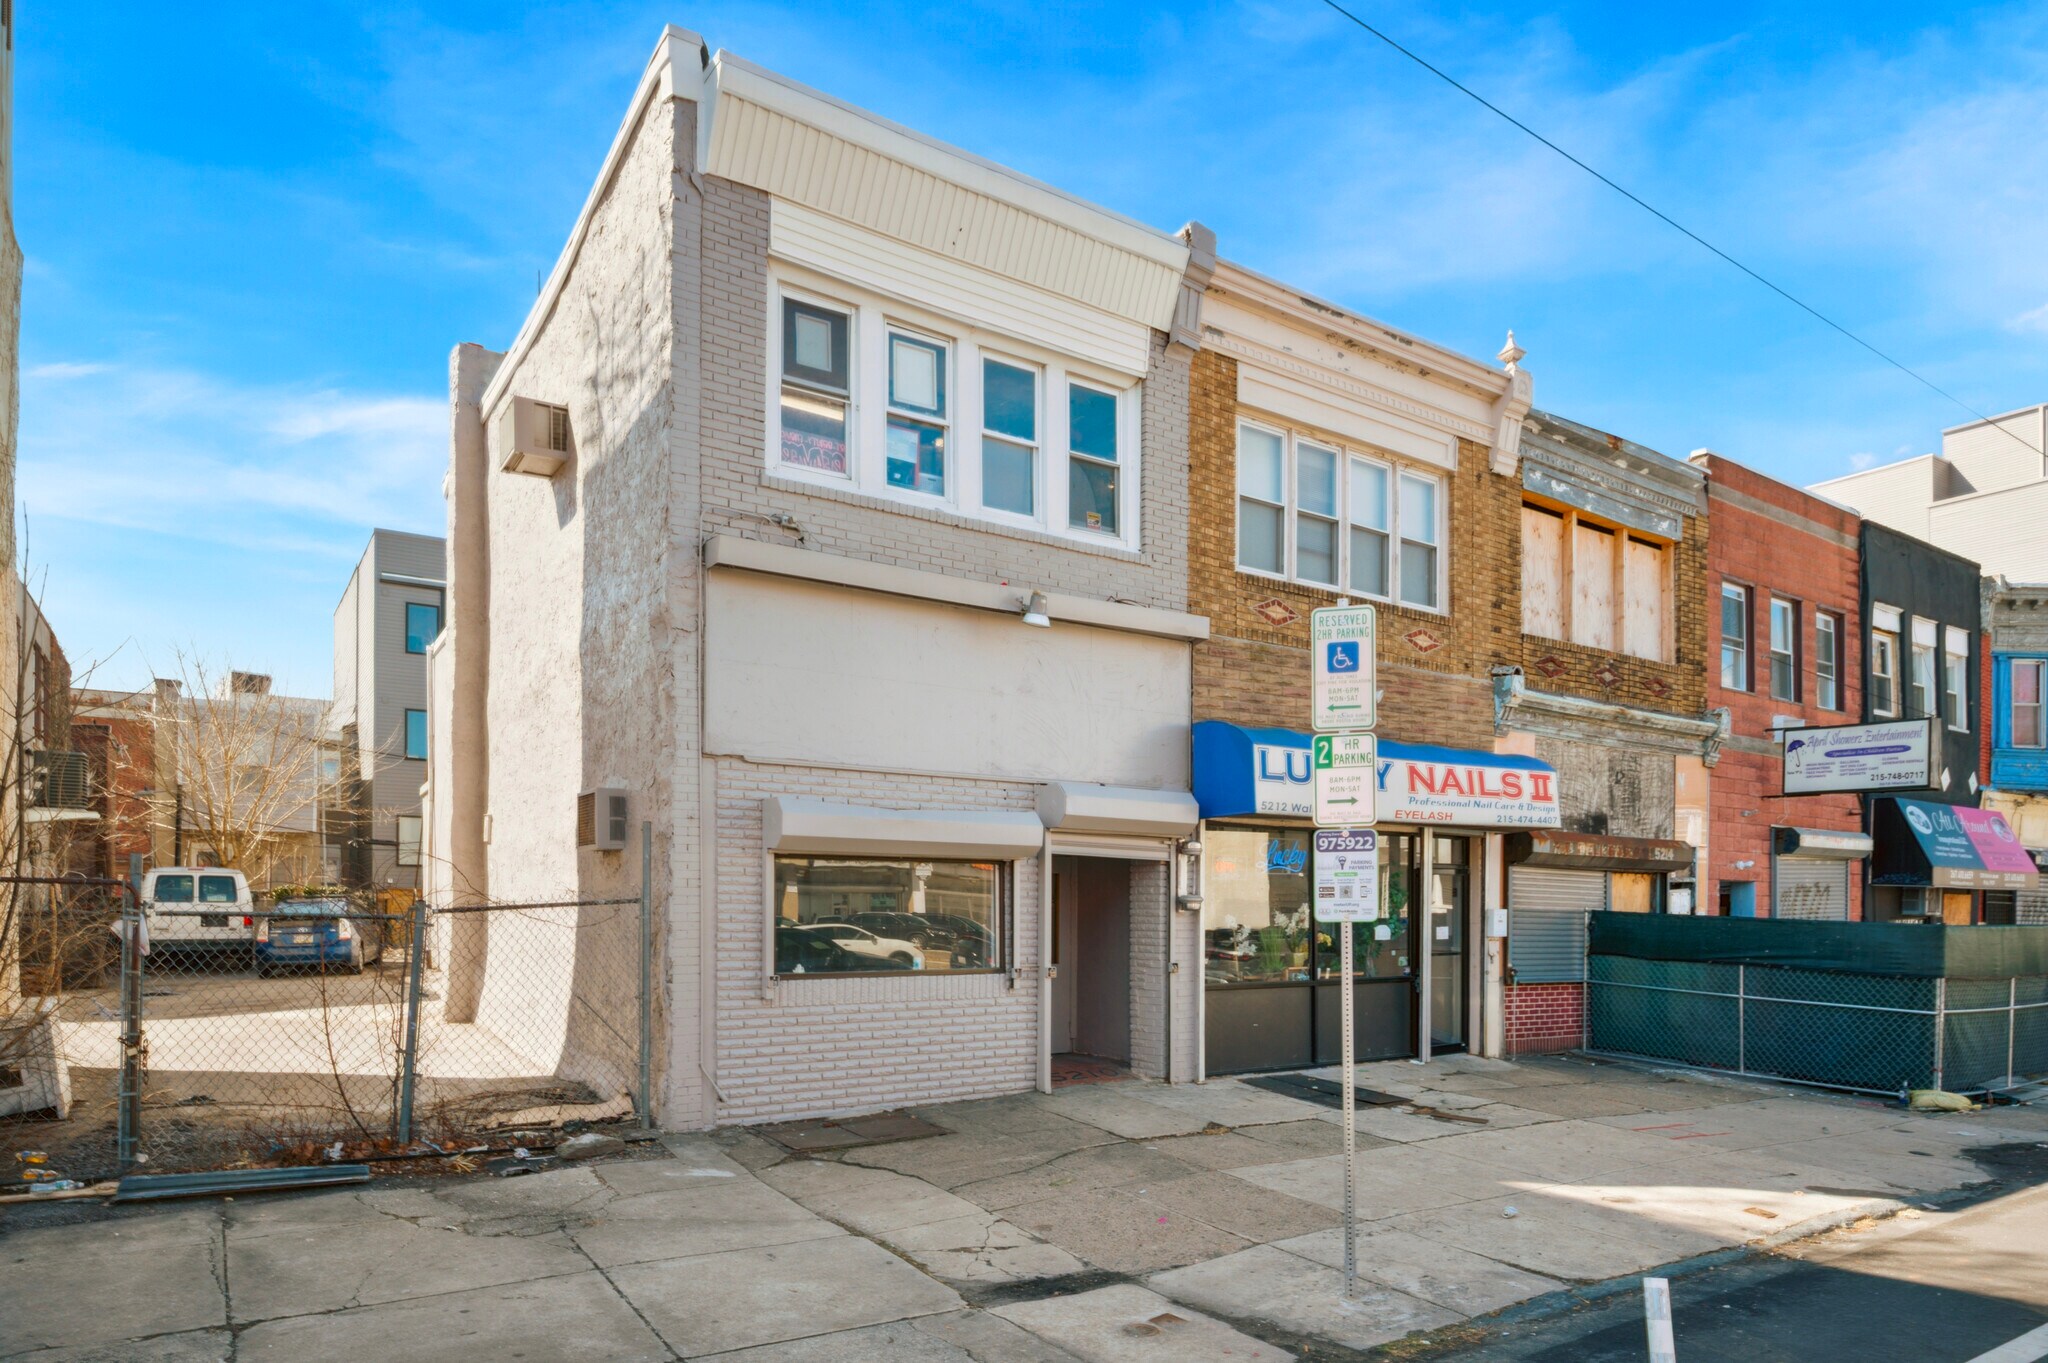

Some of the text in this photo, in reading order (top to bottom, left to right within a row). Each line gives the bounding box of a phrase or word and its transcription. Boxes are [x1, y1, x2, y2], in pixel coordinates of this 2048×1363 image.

[1319, 613, 1368, 627] RESERVED
[1317, 626, 1370, 641] 2HR PARKING
[1328, 694, 1359, 702] MON-SAT
[1807, 731, 1829, 752] April
[1865, 725, 1924, 742] Entertainment
[1318, 738, 1360, 764] 2 HR
[1334, 752, 1372, 765] PARKING
[1258, 747, 1553, 803] LUY NAILS II
[1329, 775, 1361, 784] 8AM-6PM
[1870, 771, 1925, 781] 215-748-0717
[1329, 785, 1361, 793] MON-SAT
[1261, 801, 1312, 813] 5212 Wal
[1408, 796, 1556, 814] Professional Nail Care & Design
[1394, 809, 1453, 822] EYELASH
[1496, 814, 1558, 825] 215-474-4407
[1318, 836, 1374, 851] 975922
[1265, 839, 1307, 872] Lucky
